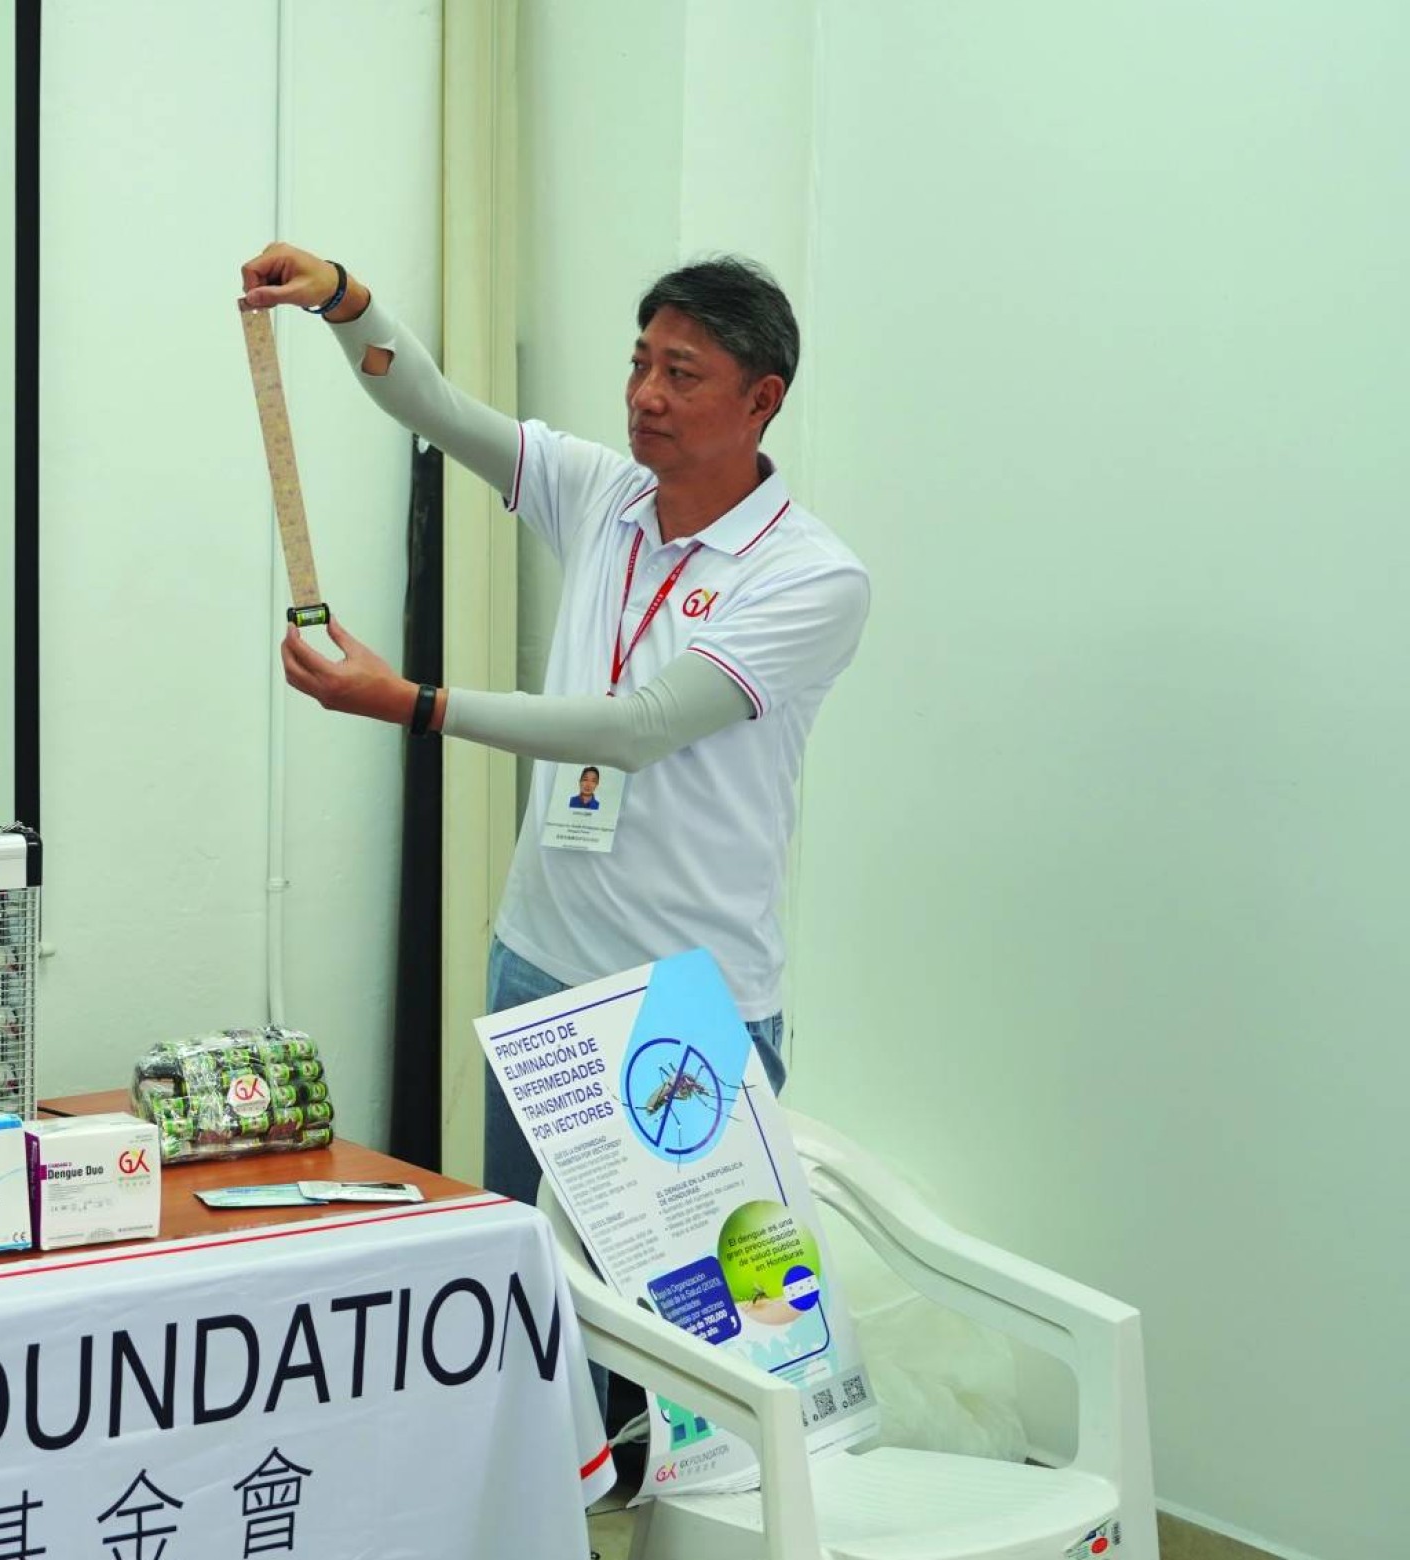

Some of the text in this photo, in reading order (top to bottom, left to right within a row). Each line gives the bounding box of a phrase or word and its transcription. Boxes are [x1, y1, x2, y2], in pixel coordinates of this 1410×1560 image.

[494, 1022, 578, 1060] PROYECTO DE
[503, 1037, 599, 1080] ELIMINACIÓN DE
[513, 1058, 606, 1101] ENFERMEDADES
[521, 1081, 604, 1120] TRANSMITIDAS
[531, 1100, 615, 1141] POR VECTORES
[47, 1168, 83, 1181] Dengue
[86, 1165, 104, 1176] Duo
[728, 1218, 793, 1247] El dengue es una
[738, 1257, 749, 1267] de
[750, 1249, 772, 1264] salud
[766, 1249, 805, 1268] Honduras
